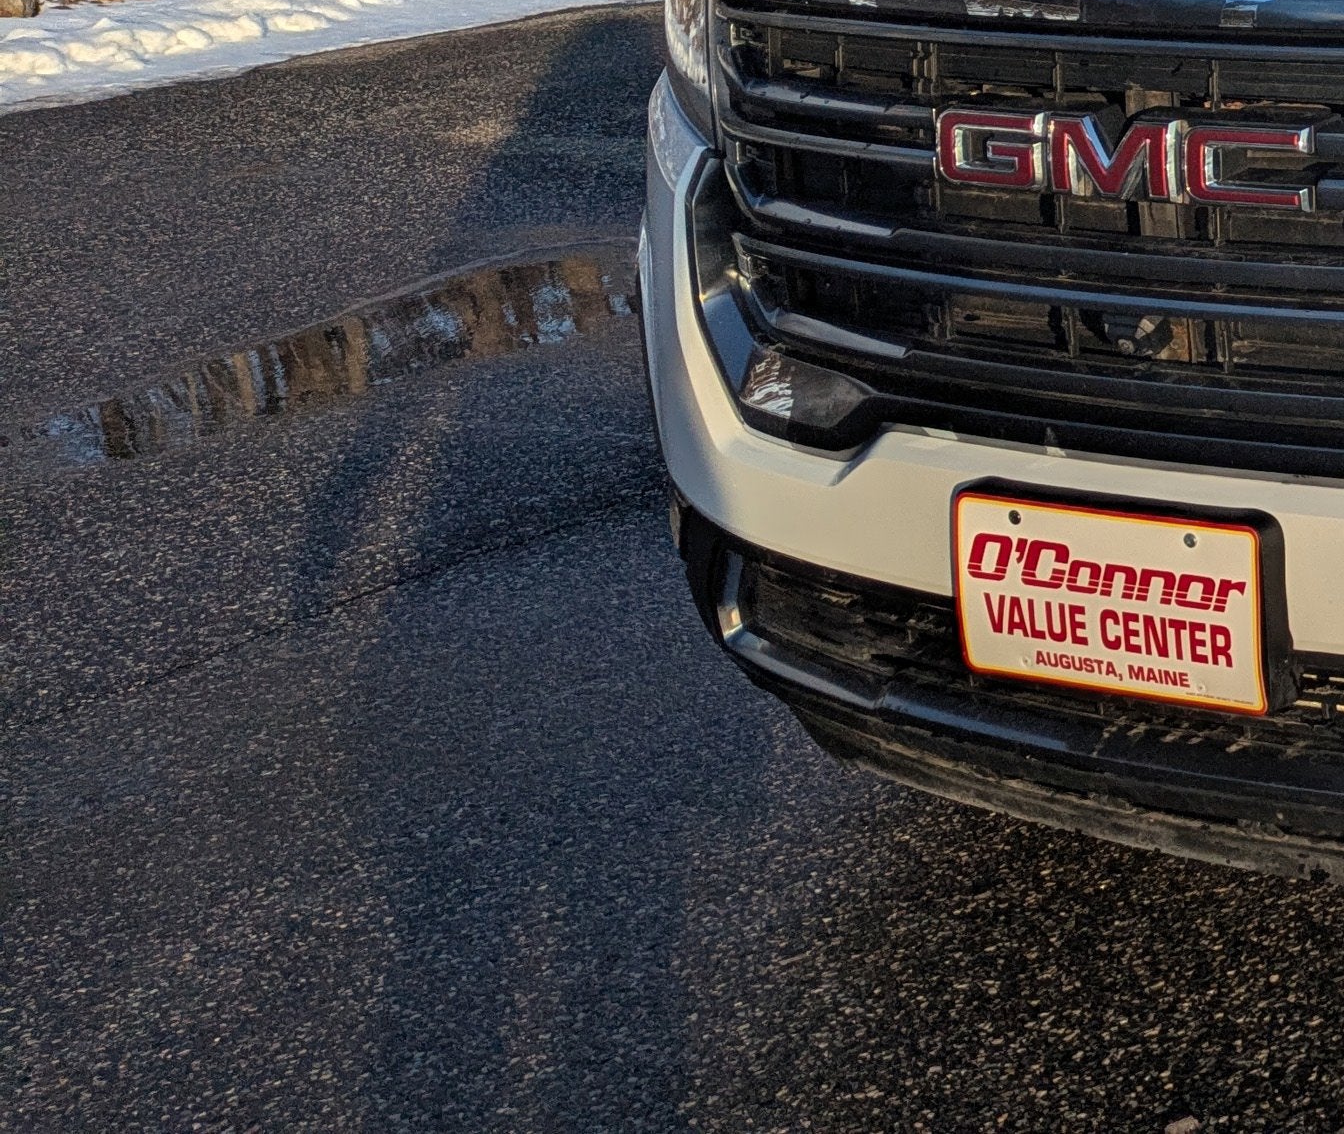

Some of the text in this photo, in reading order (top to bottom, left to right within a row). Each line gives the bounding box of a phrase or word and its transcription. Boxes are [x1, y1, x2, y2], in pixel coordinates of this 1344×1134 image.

[936, 107, 1316, 213] GMC
[967, 532, 1246, 612] O'Connor
[983, 592, 1233, 668] VALUE CENTER
[1035, 650, 1190, 688] AUGUSTA, MAINE
